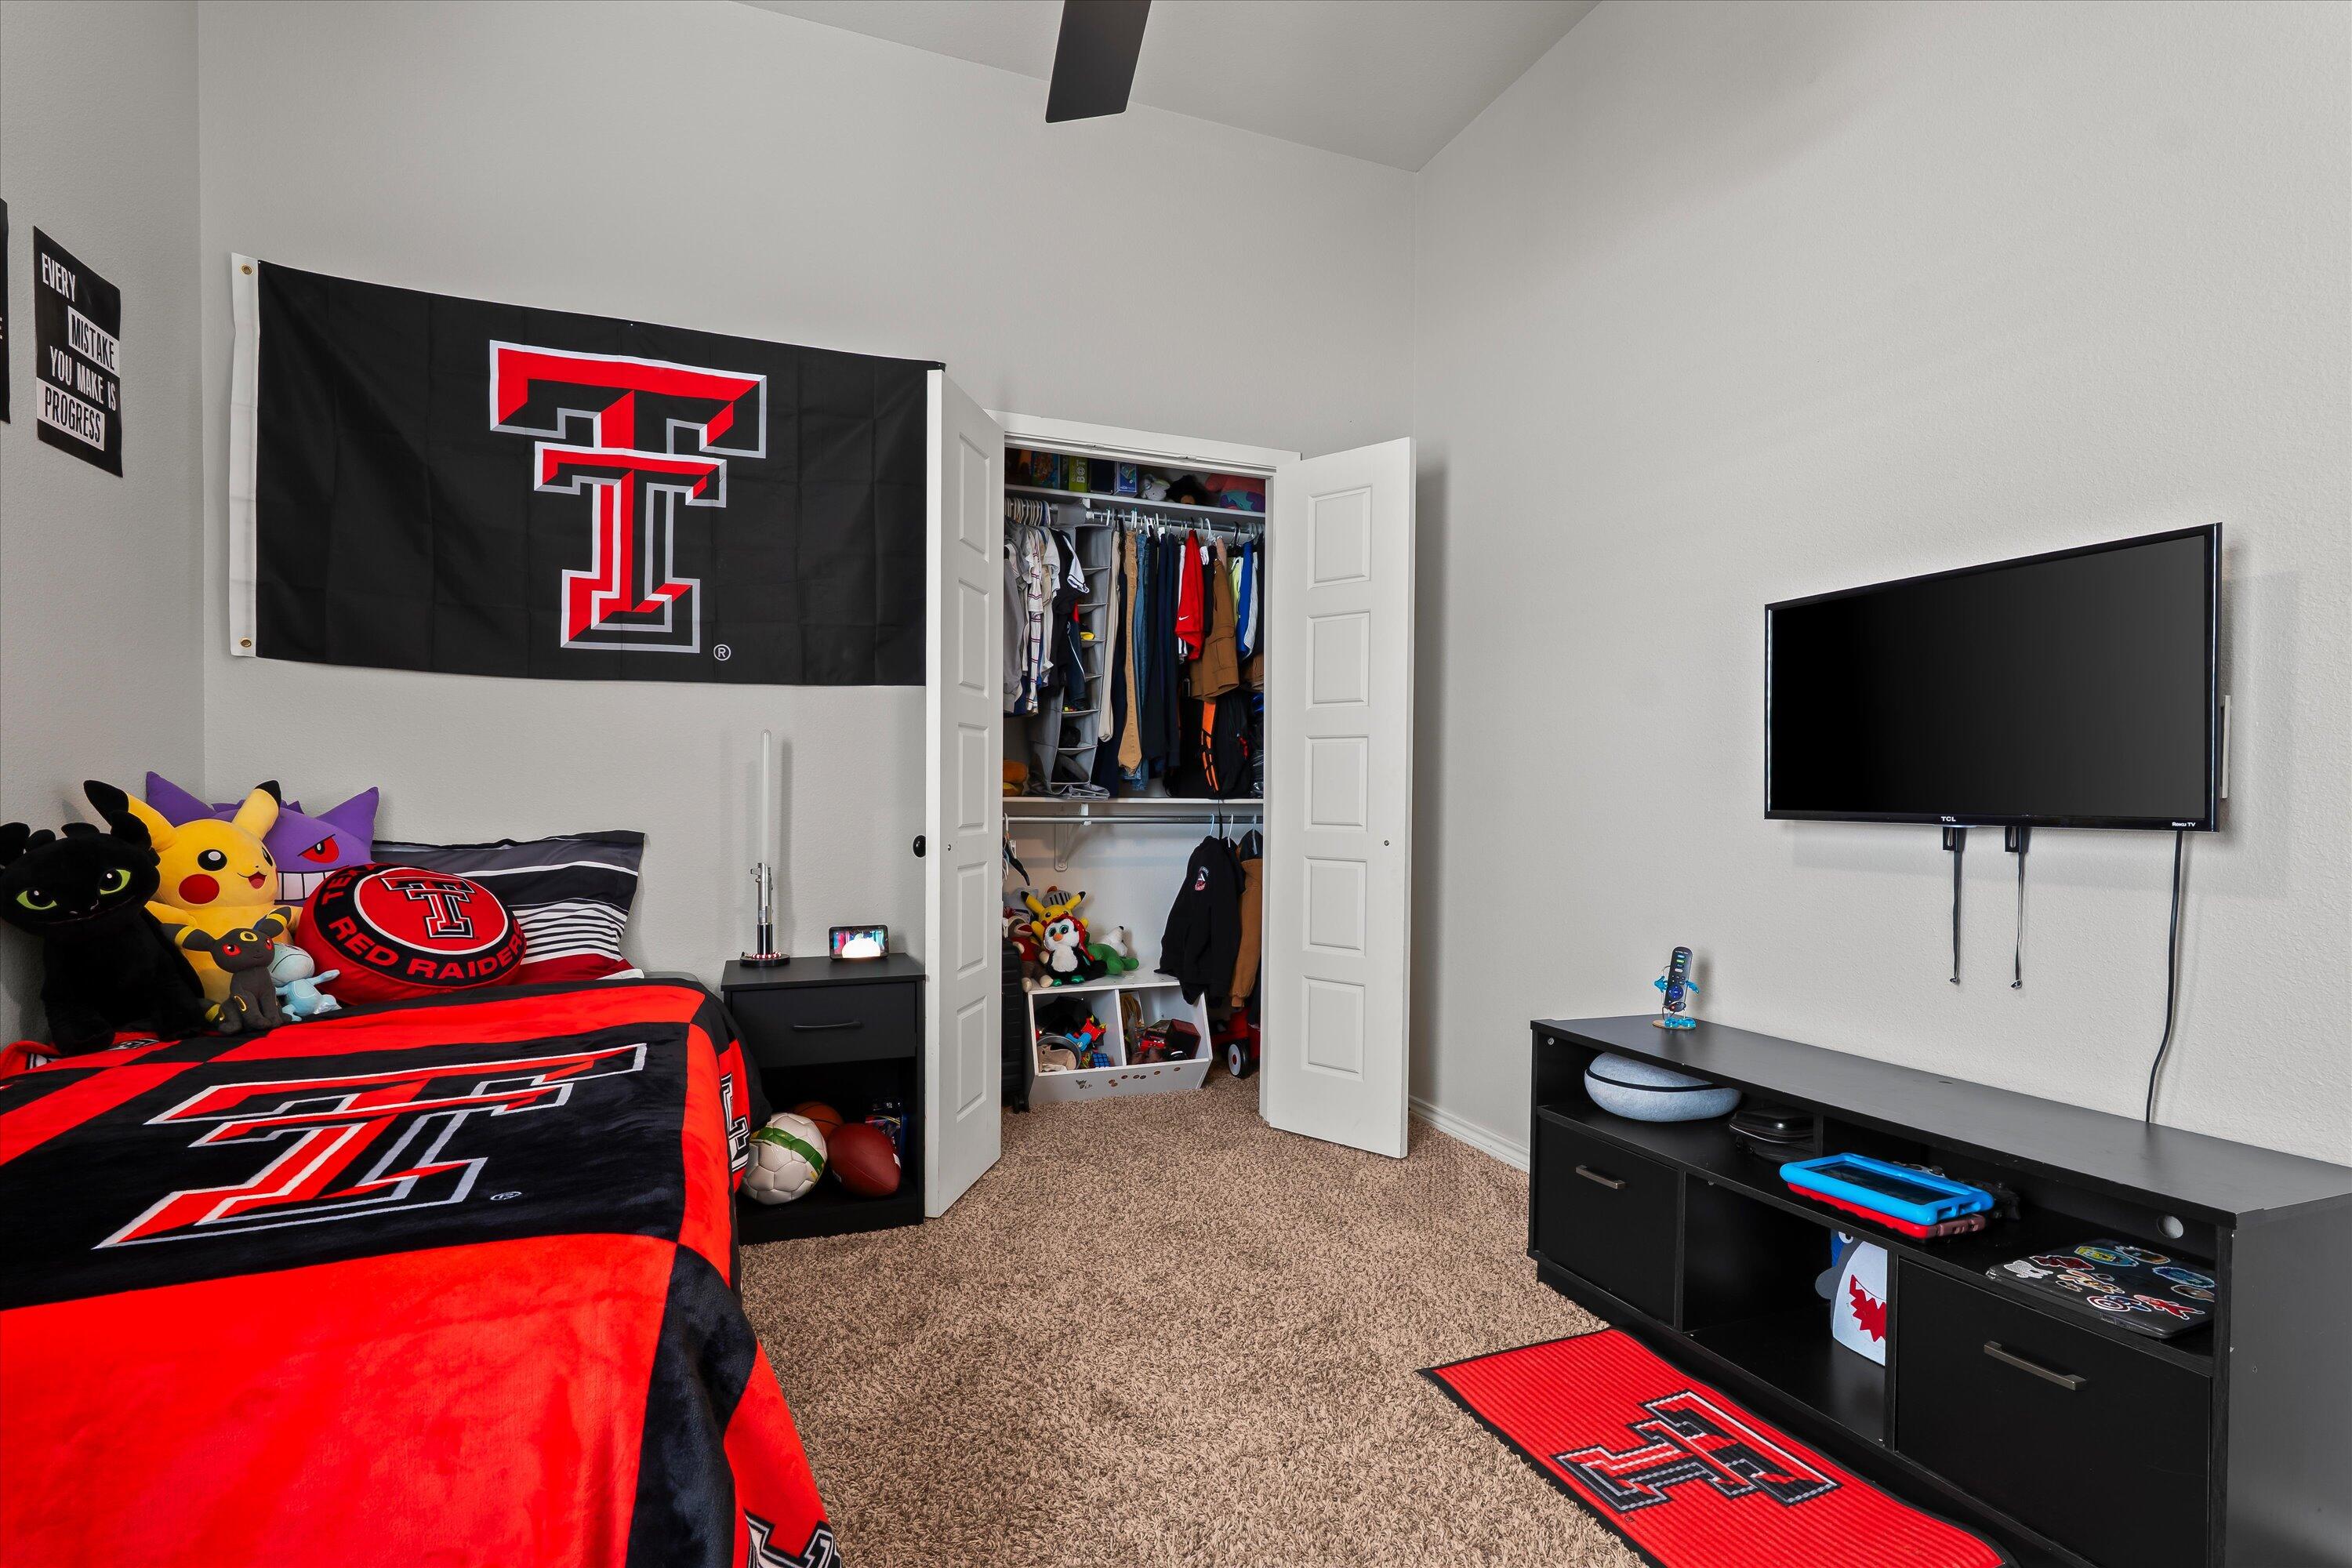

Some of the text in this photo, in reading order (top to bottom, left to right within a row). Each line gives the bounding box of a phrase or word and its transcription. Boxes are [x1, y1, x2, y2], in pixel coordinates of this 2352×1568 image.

[42, 252, 76, 302] EVERY
[71, 314, 115, 372] MISTAKE
[49, 345, 117, 412] YOU MAKE IS
[45, 386, 100, 443] PROGRESS
[328, 916, 399, 967] RED
